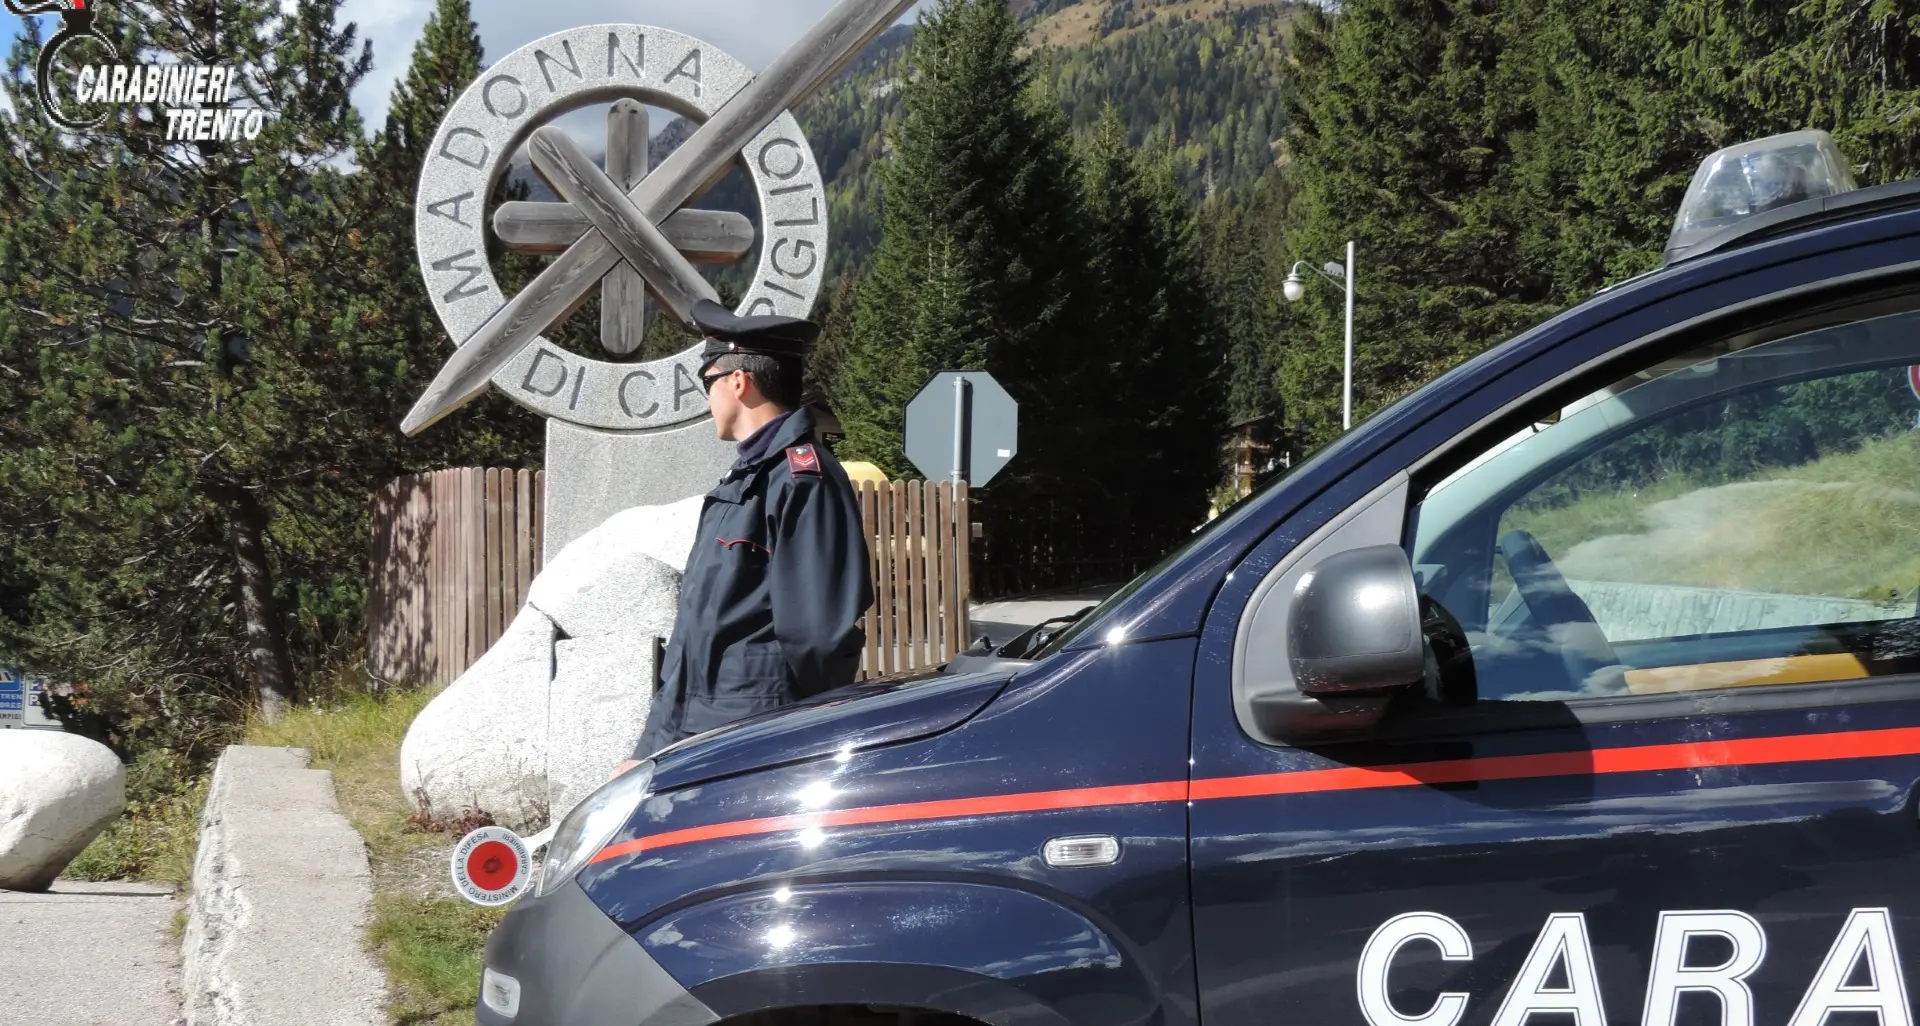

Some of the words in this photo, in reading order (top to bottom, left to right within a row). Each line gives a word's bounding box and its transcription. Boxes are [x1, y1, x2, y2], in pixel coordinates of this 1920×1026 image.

[427, 31, 703, 304] MADONNA
[521, 346, 586, 411] DI
[460, 831, 489, 856] DIFESA
[502, 832, 529, 875] CARABINIERI
[456, 857, 469, 887] DELLA
[468, 884, 519, 902] MINISTERO
[1357, 907, 1915, 1026] CARA
